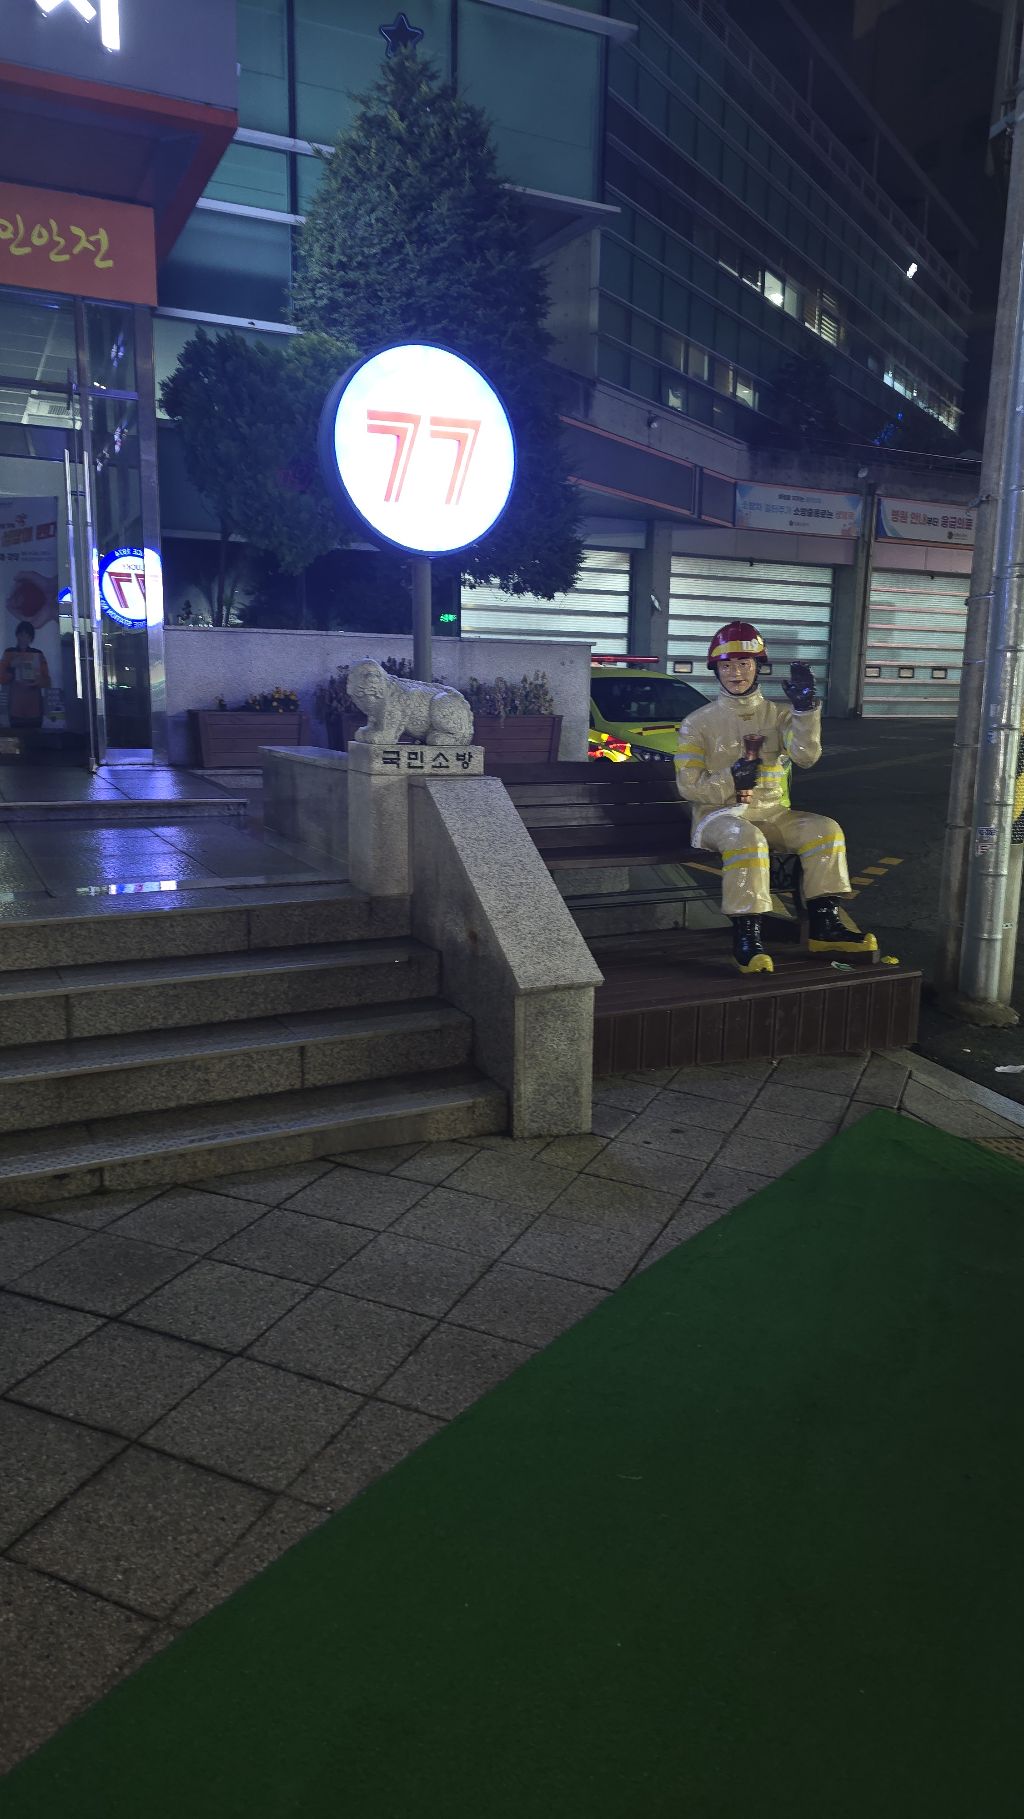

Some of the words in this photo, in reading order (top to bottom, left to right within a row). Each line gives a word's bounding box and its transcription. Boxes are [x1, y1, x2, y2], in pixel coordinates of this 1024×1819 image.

[366, 409, 482, 505] 77
[891, 509, 908, 524] 병원
[381, 750, 473, 770] 국민소방
